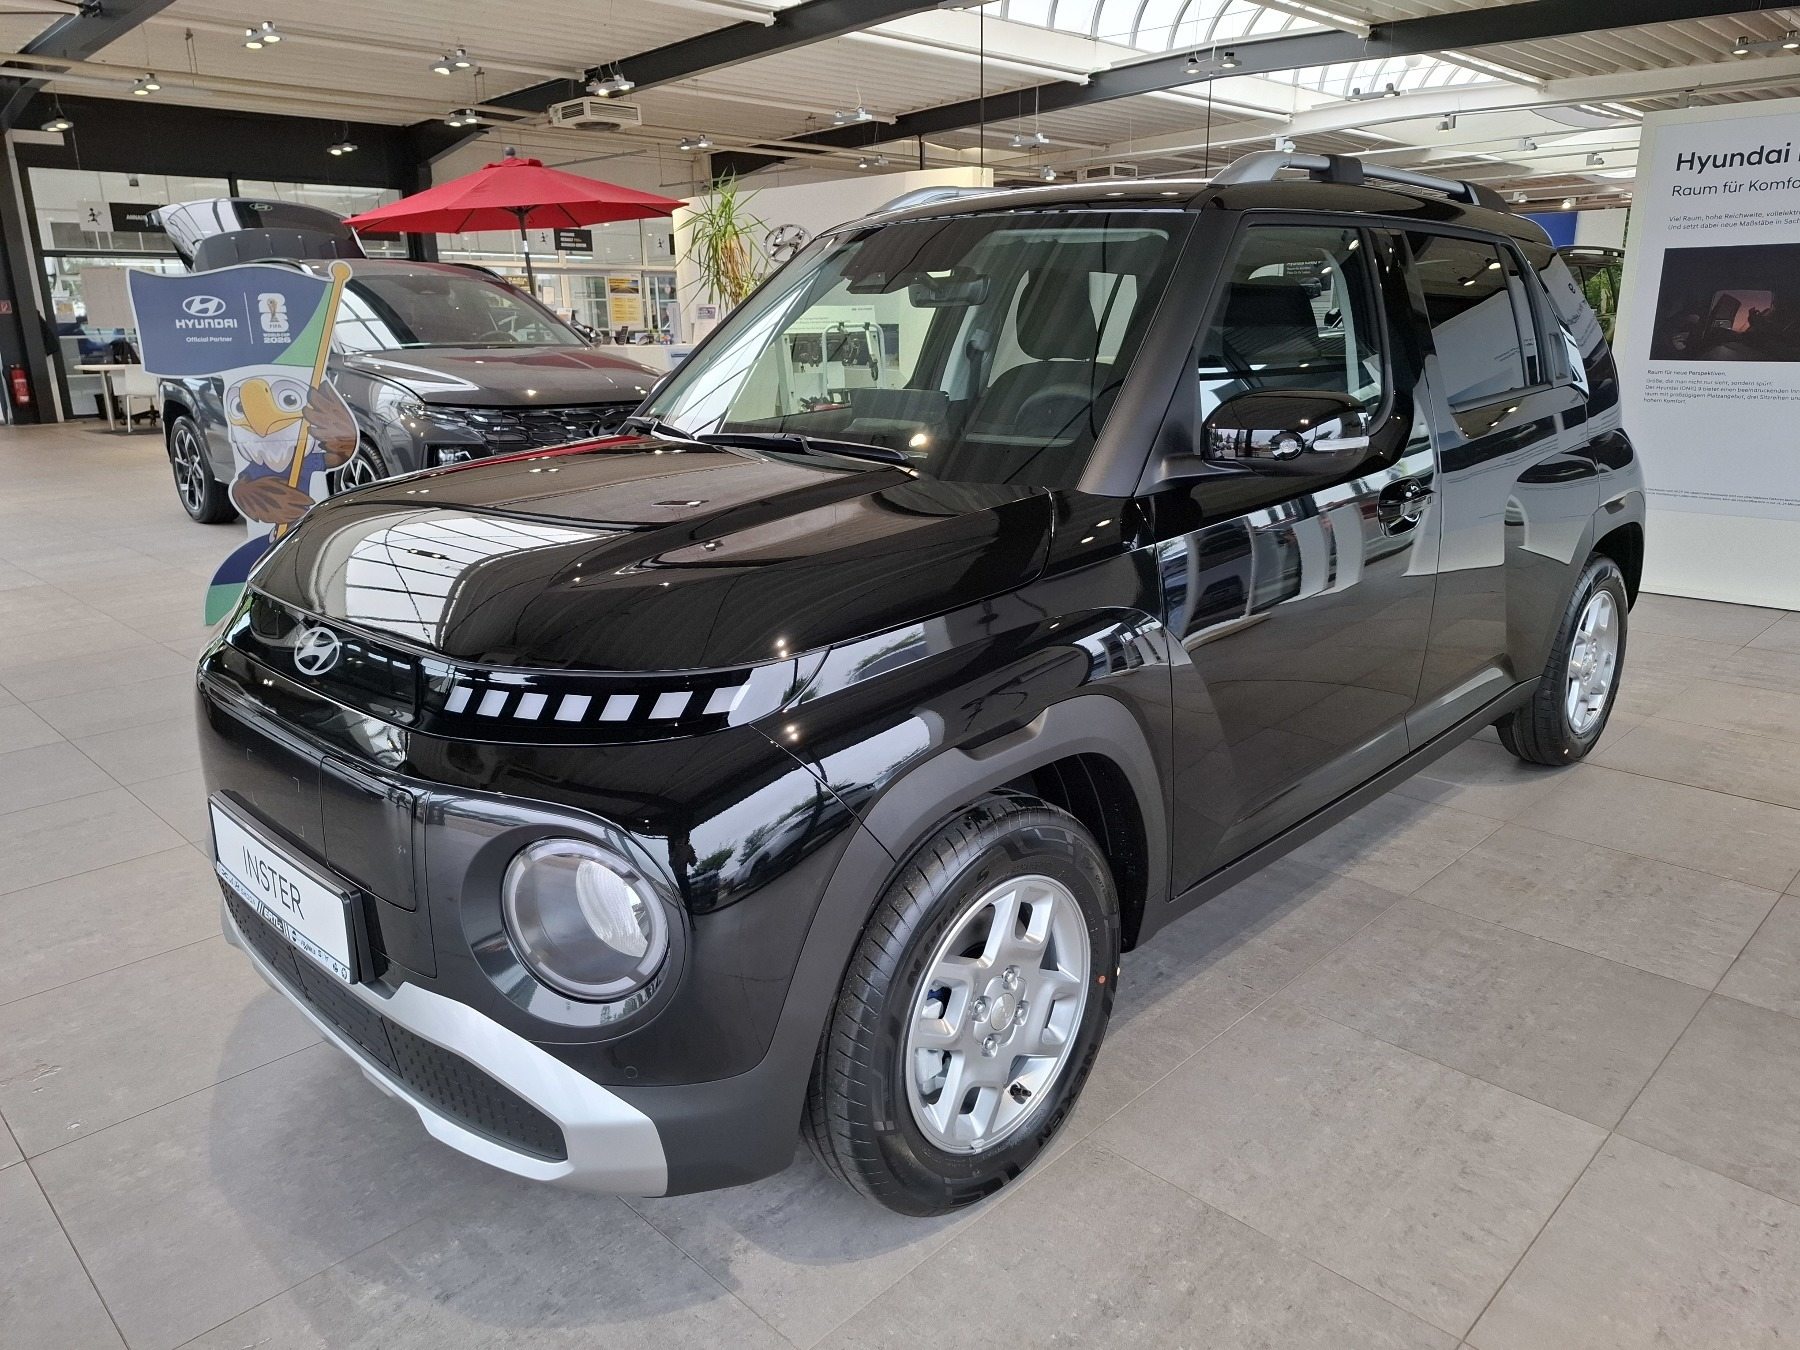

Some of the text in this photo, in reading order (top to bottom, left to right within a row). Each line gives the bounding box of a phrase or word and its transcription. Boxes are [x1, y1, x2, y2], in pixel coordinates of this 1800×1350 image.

[1676, 142, 1792, 174] Hyundai
[1672, 177, 1800, 197] Raum für Komfo
[176, 318, 238, 329] HYUNDAI
[242, 845, 305, 920] INSTER
